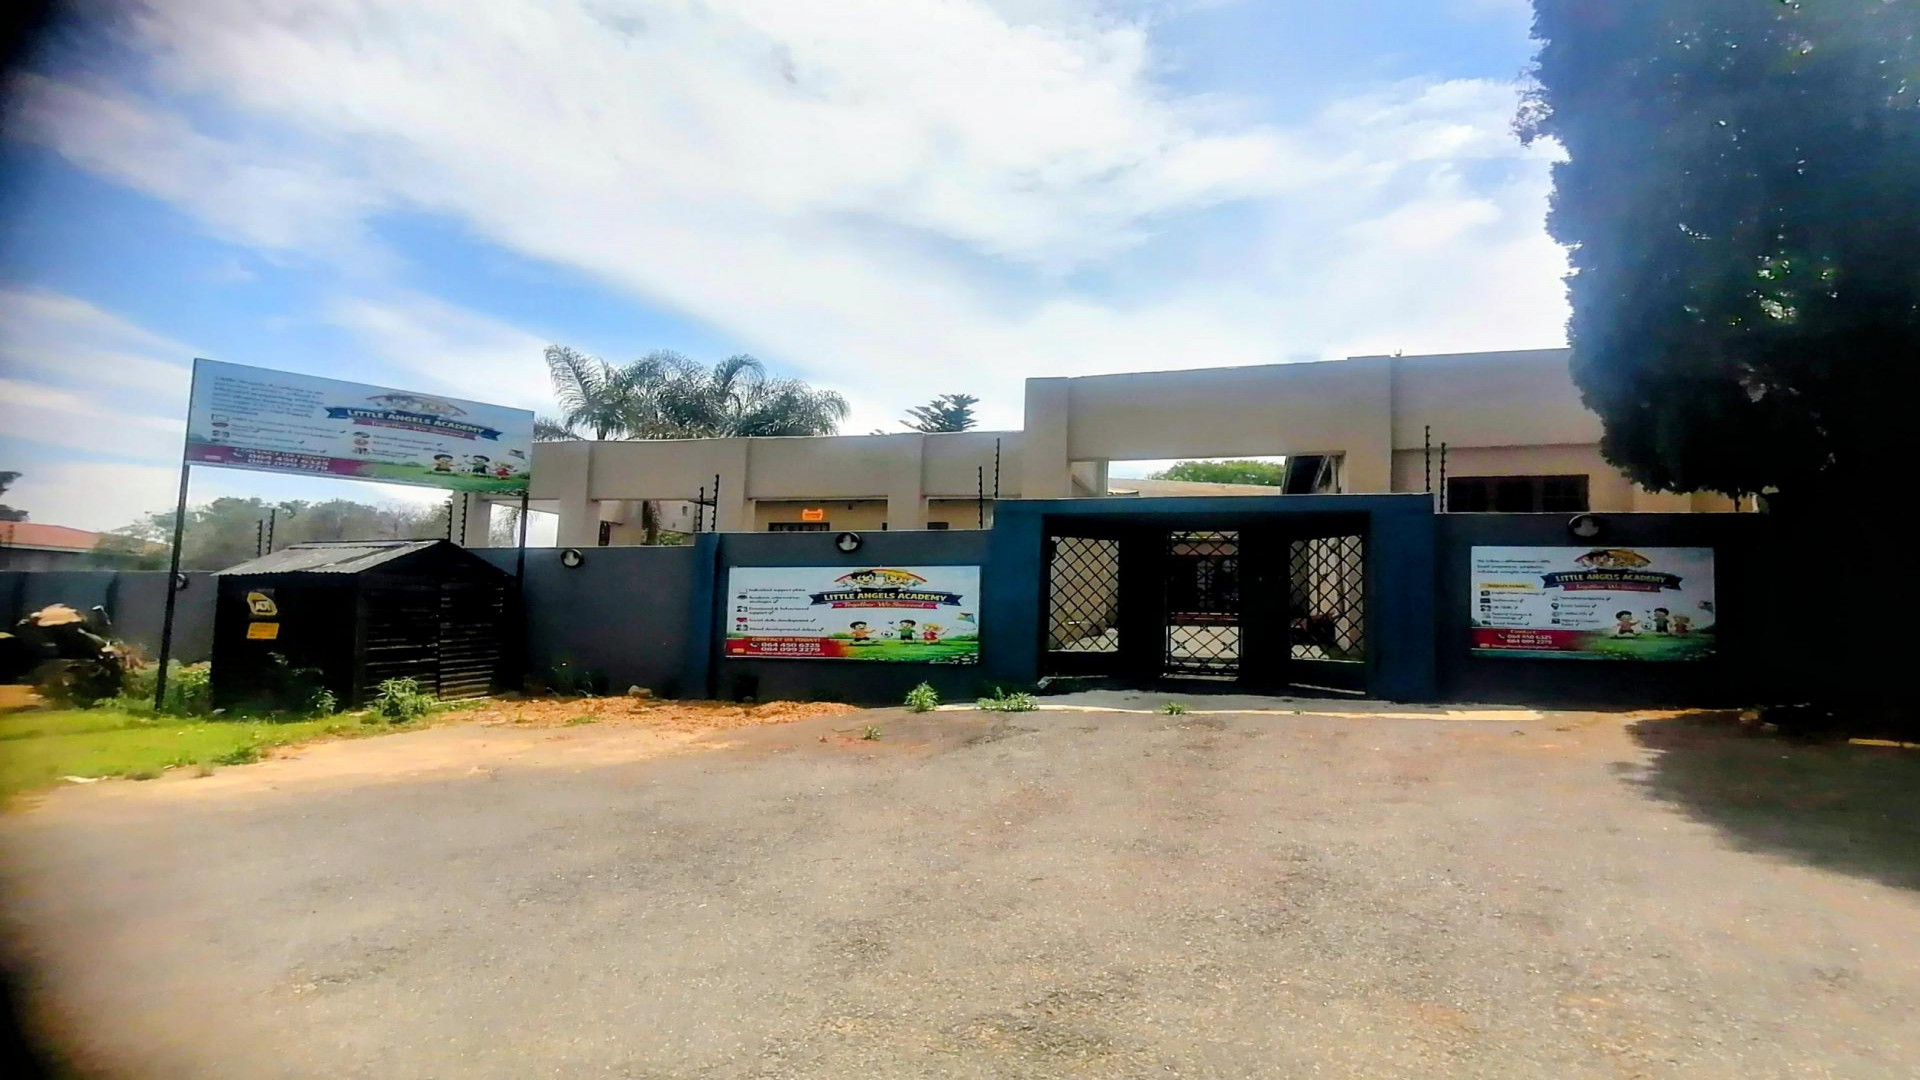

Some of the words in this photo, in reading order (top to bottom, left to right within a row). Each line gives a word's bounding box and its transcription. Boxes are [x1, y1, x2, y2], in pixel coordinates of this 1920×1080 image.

[346, 409, 385, 420] LITTLE
[387, 413, 431, 426] ANGELS
[434, 419, 485, 435] ACADEMY
[248, 453, 272, 462] 064
[274, 455, 298, 464] 450
[300, 458, 329, 466] 6325
[1555, 574, 1584, 582] LITTLE
[1586, 573, 1620, 581] ANGELS
[1622, 573, 1666, 583] ACADEMY
[824, 593, 855, 601] LITTLE
[857, 592, 896, 600] ANGELS
[897, 592, 948, 602] ACADEMY
